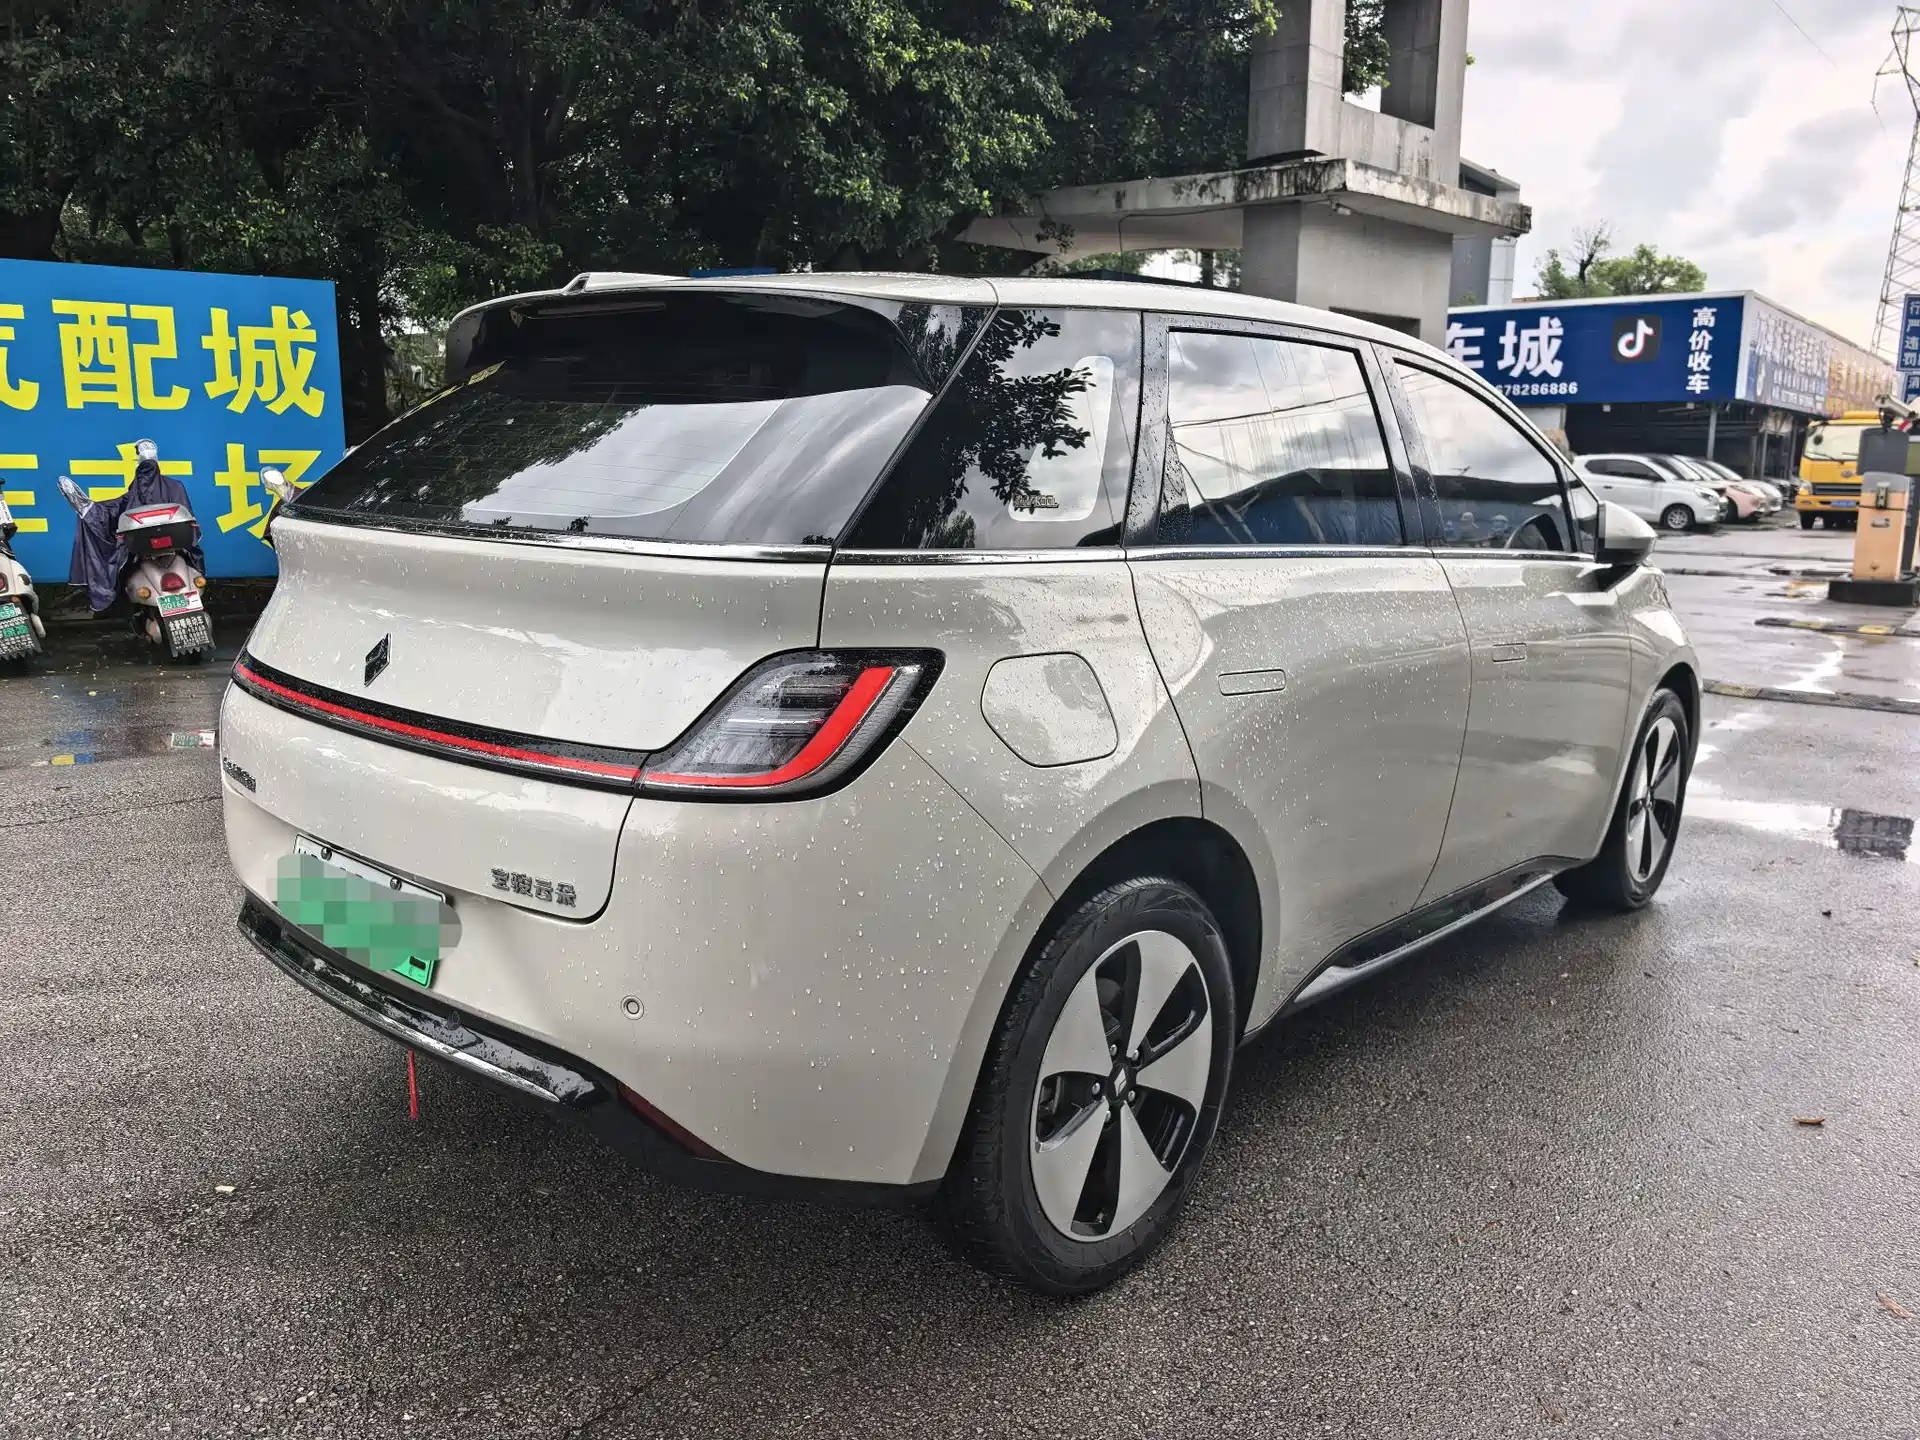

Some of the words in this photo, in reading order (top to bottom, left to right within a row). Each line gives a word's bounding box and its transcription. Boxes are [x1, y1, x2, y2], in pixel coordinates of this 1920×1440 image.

[1446, 316, 1564, 378] 车城
[1686, 307, 1717, 394] 高价收车
